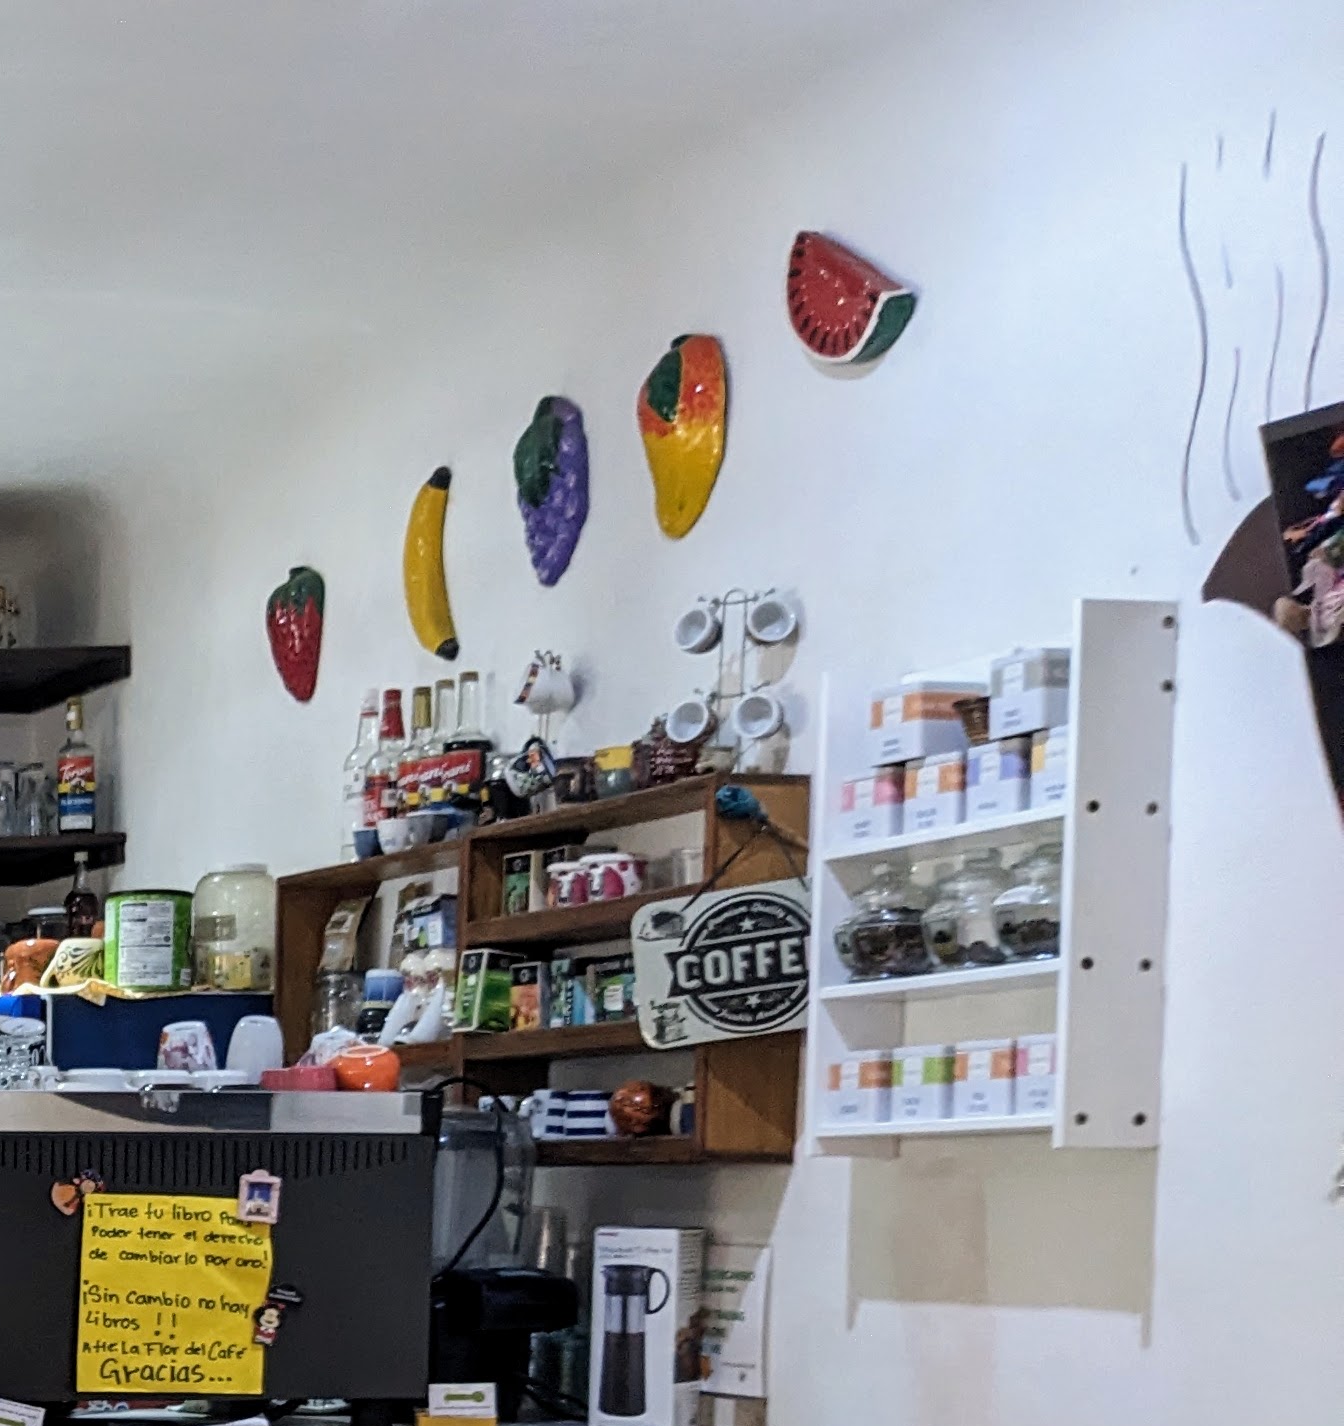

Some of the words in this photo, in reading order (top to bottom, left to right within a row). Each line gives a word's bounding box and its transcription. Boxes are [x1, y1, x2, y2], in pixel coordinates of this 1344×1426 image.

[676, 937, 804, 989] COFFE
[145, 1203, 163, 1220] tu
[173, 1203, 212, 1222] libro
[138, 1227, 175, 1240] tener
[184, 1230, 197, 1241] el
[89, 1248, 108, 1260] de
[198, 1297, 218, 1309] no
[220, 1295, 250, 1319] hay
[145, 1343, 179, 1356] Flor
[184, 1341, 206, 1356] del
